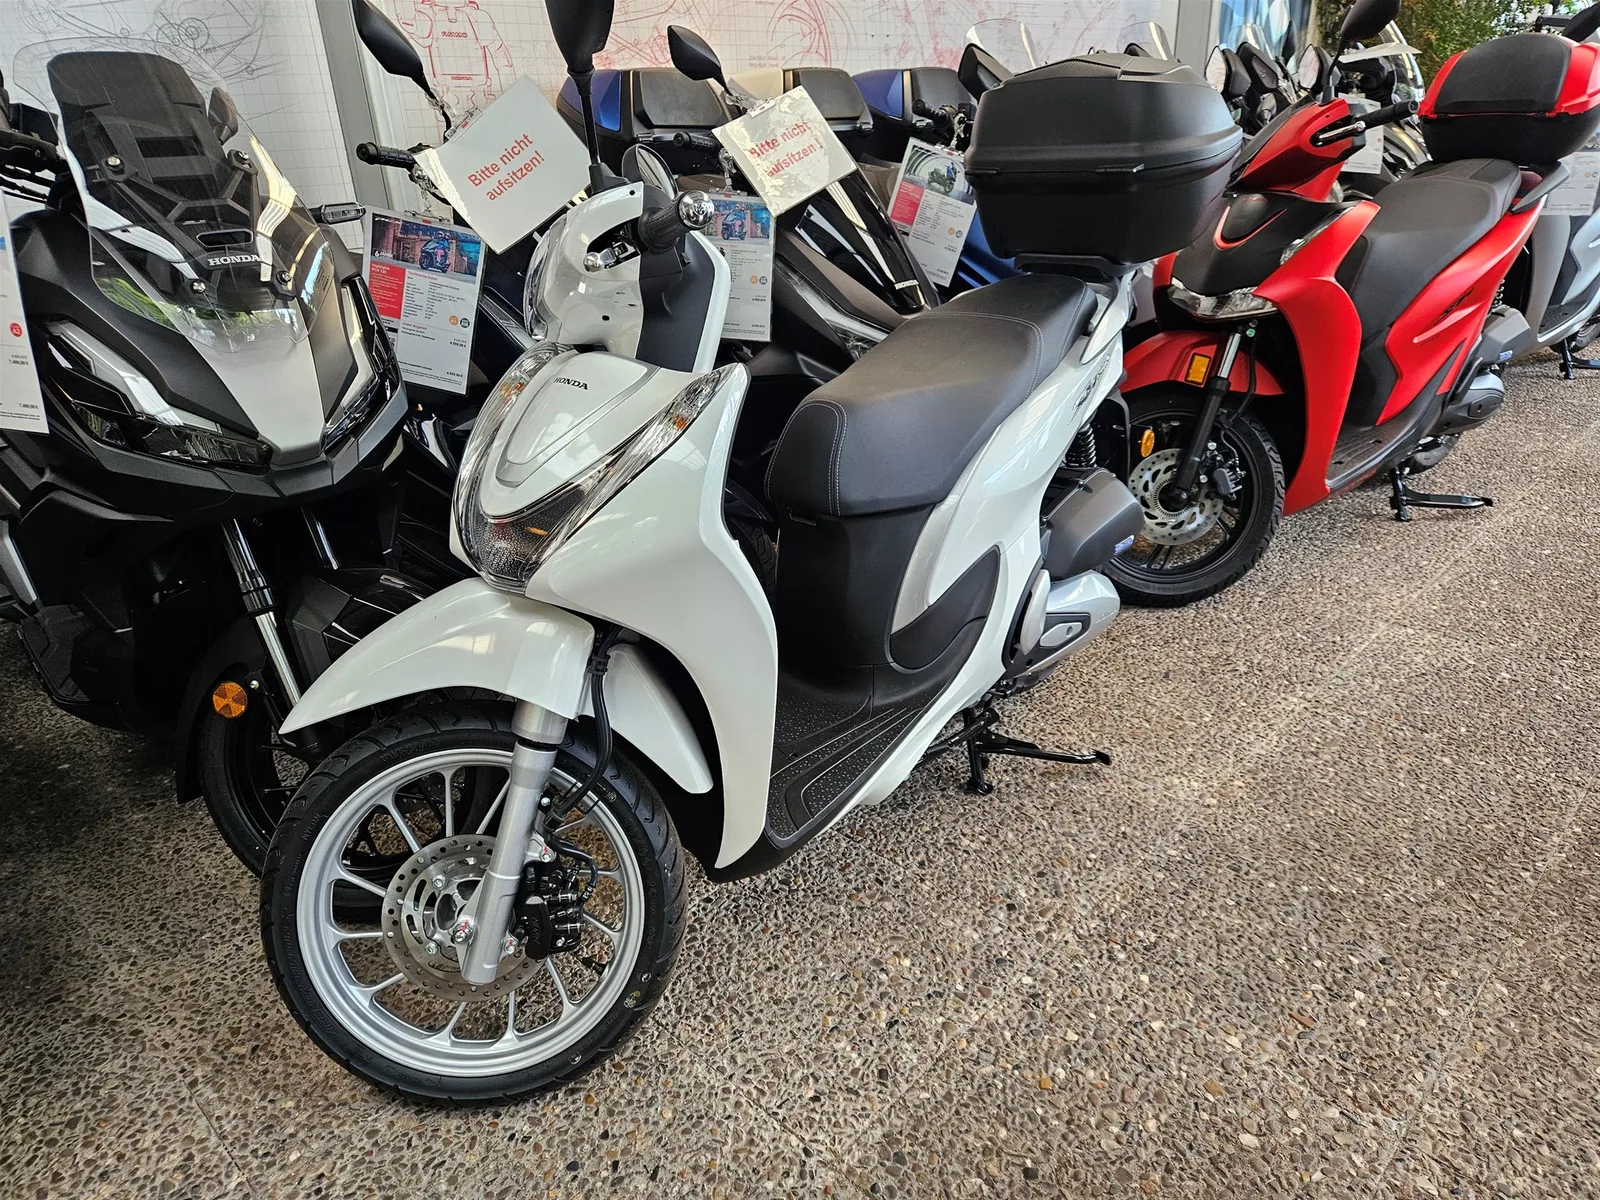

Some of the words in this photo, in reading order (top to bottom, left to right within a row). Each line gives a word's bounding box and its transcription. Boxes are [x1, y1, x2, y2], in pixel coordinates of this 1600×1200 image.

[748, 138, 780, 159] Bitte
[780, 120, 812, 143] nicht
[468, 163, 500, 187] Bitte
[500, 133, 533, 165] nicht
[486, 150, 545, 201] aufsitzen!
[207, 254, 263, 266] HONDA
[553, 377, 589, 390] HONDA
